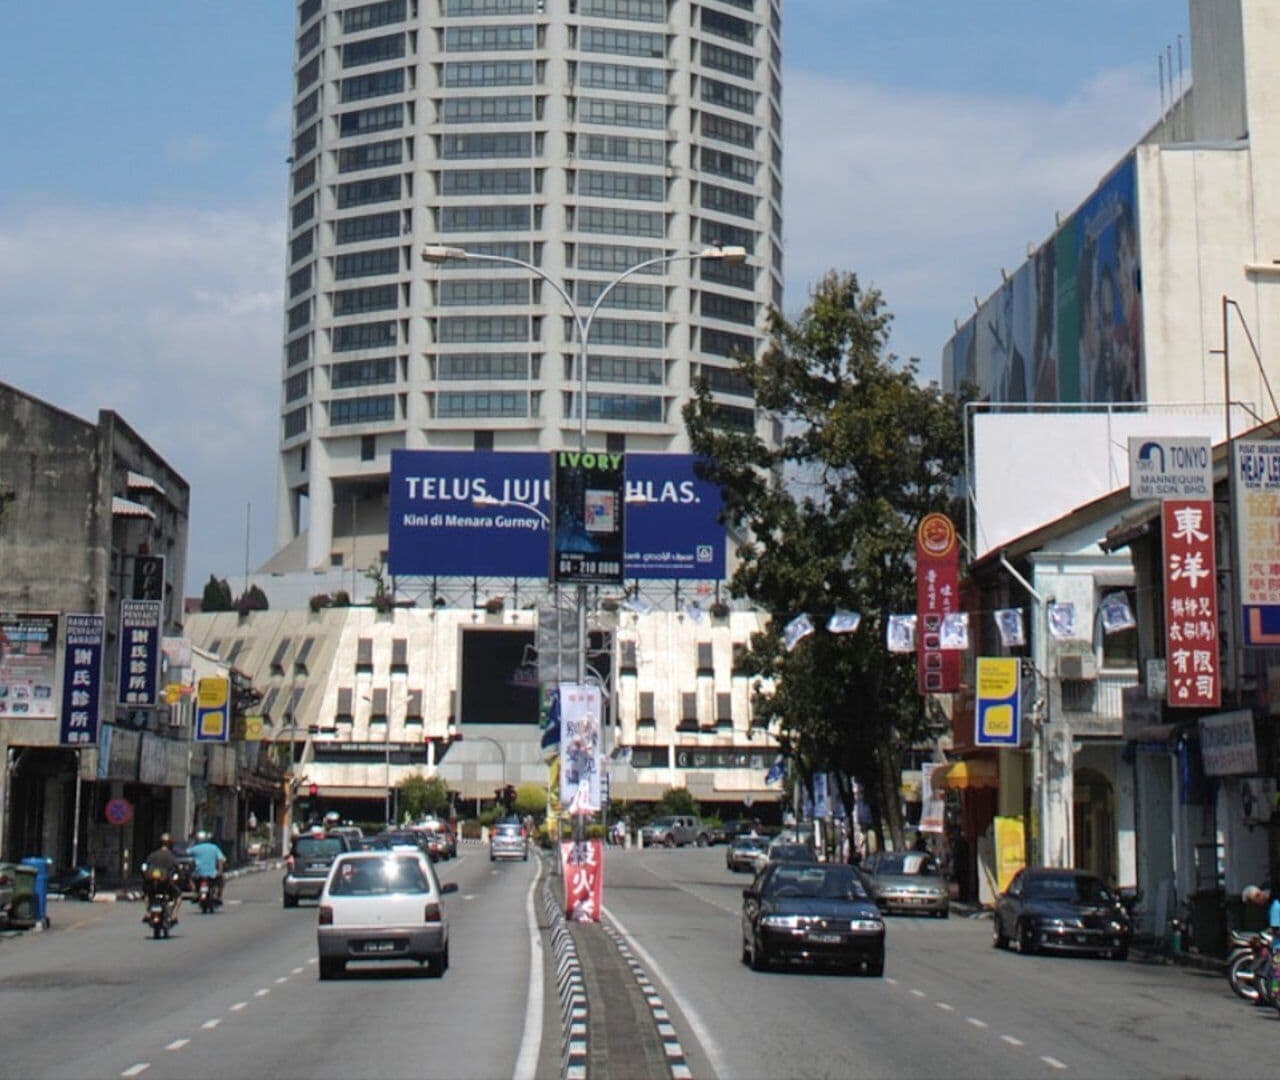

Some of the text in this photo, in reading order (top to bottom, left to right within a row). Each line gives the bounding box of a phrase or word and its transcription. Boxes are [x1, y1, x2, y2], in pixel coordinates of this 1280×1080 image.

[560, 451, 622, 471] IVORY
[1169, 445, 1208, 469] TONYO
[1140, 474, 1204, 484] MANNEQUIN
[1240, 455, 1264, 482] HEAP
[403, 513, 540, 531] Kini di Menara Gurney
[1170, 506, 1211, 590] 東洋
